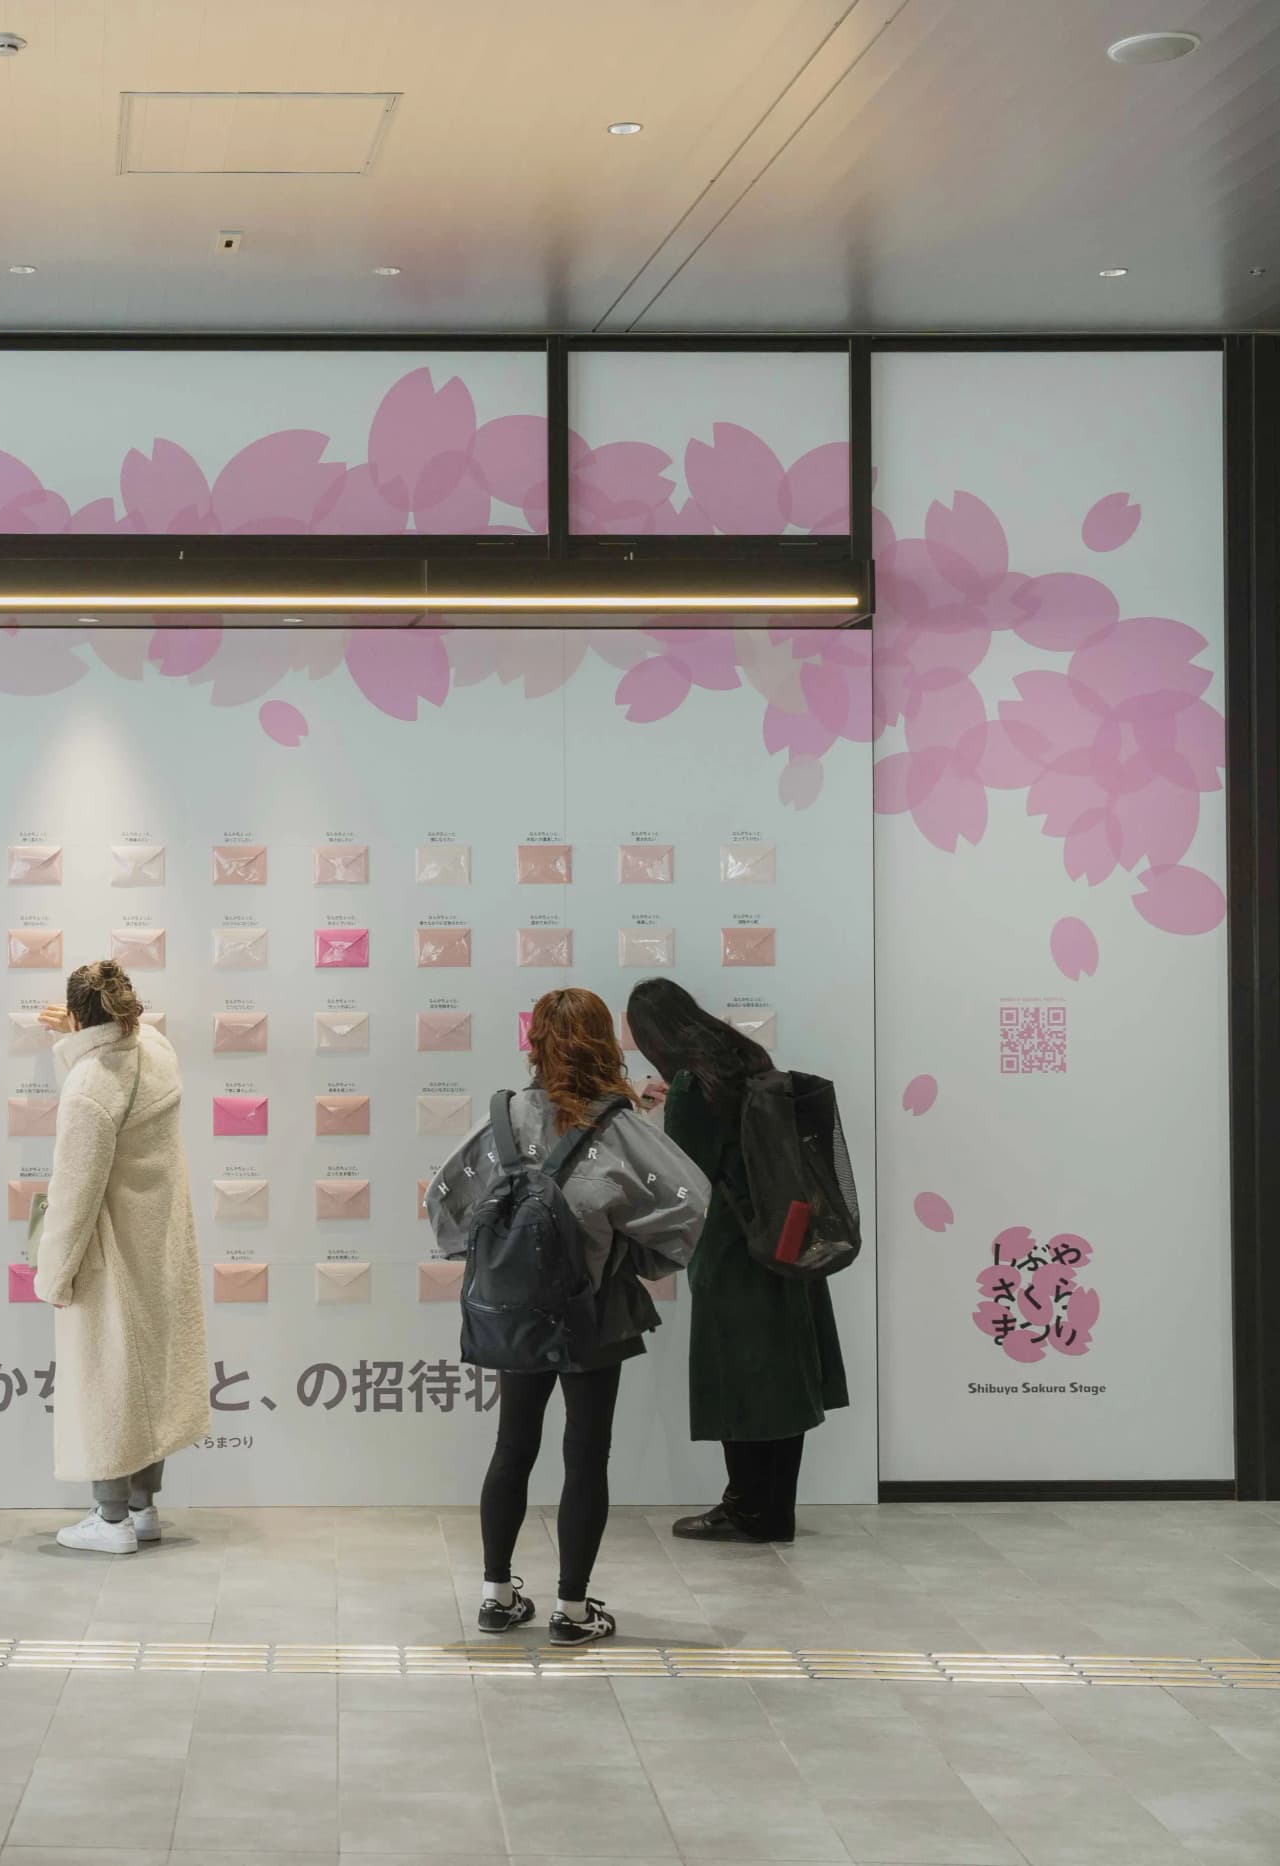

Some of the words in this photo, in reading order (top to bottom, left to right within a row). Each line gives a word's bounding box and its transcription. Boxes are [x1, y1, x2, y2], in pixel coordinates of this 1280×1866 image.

[991, 1277, 1074, 1310] さくら
[968, 1382, 1018, 1395] Shibuya
[1022, 1382, 1066, 1394] Sakura
[1069, 1382, 1107, 1396] Stage
